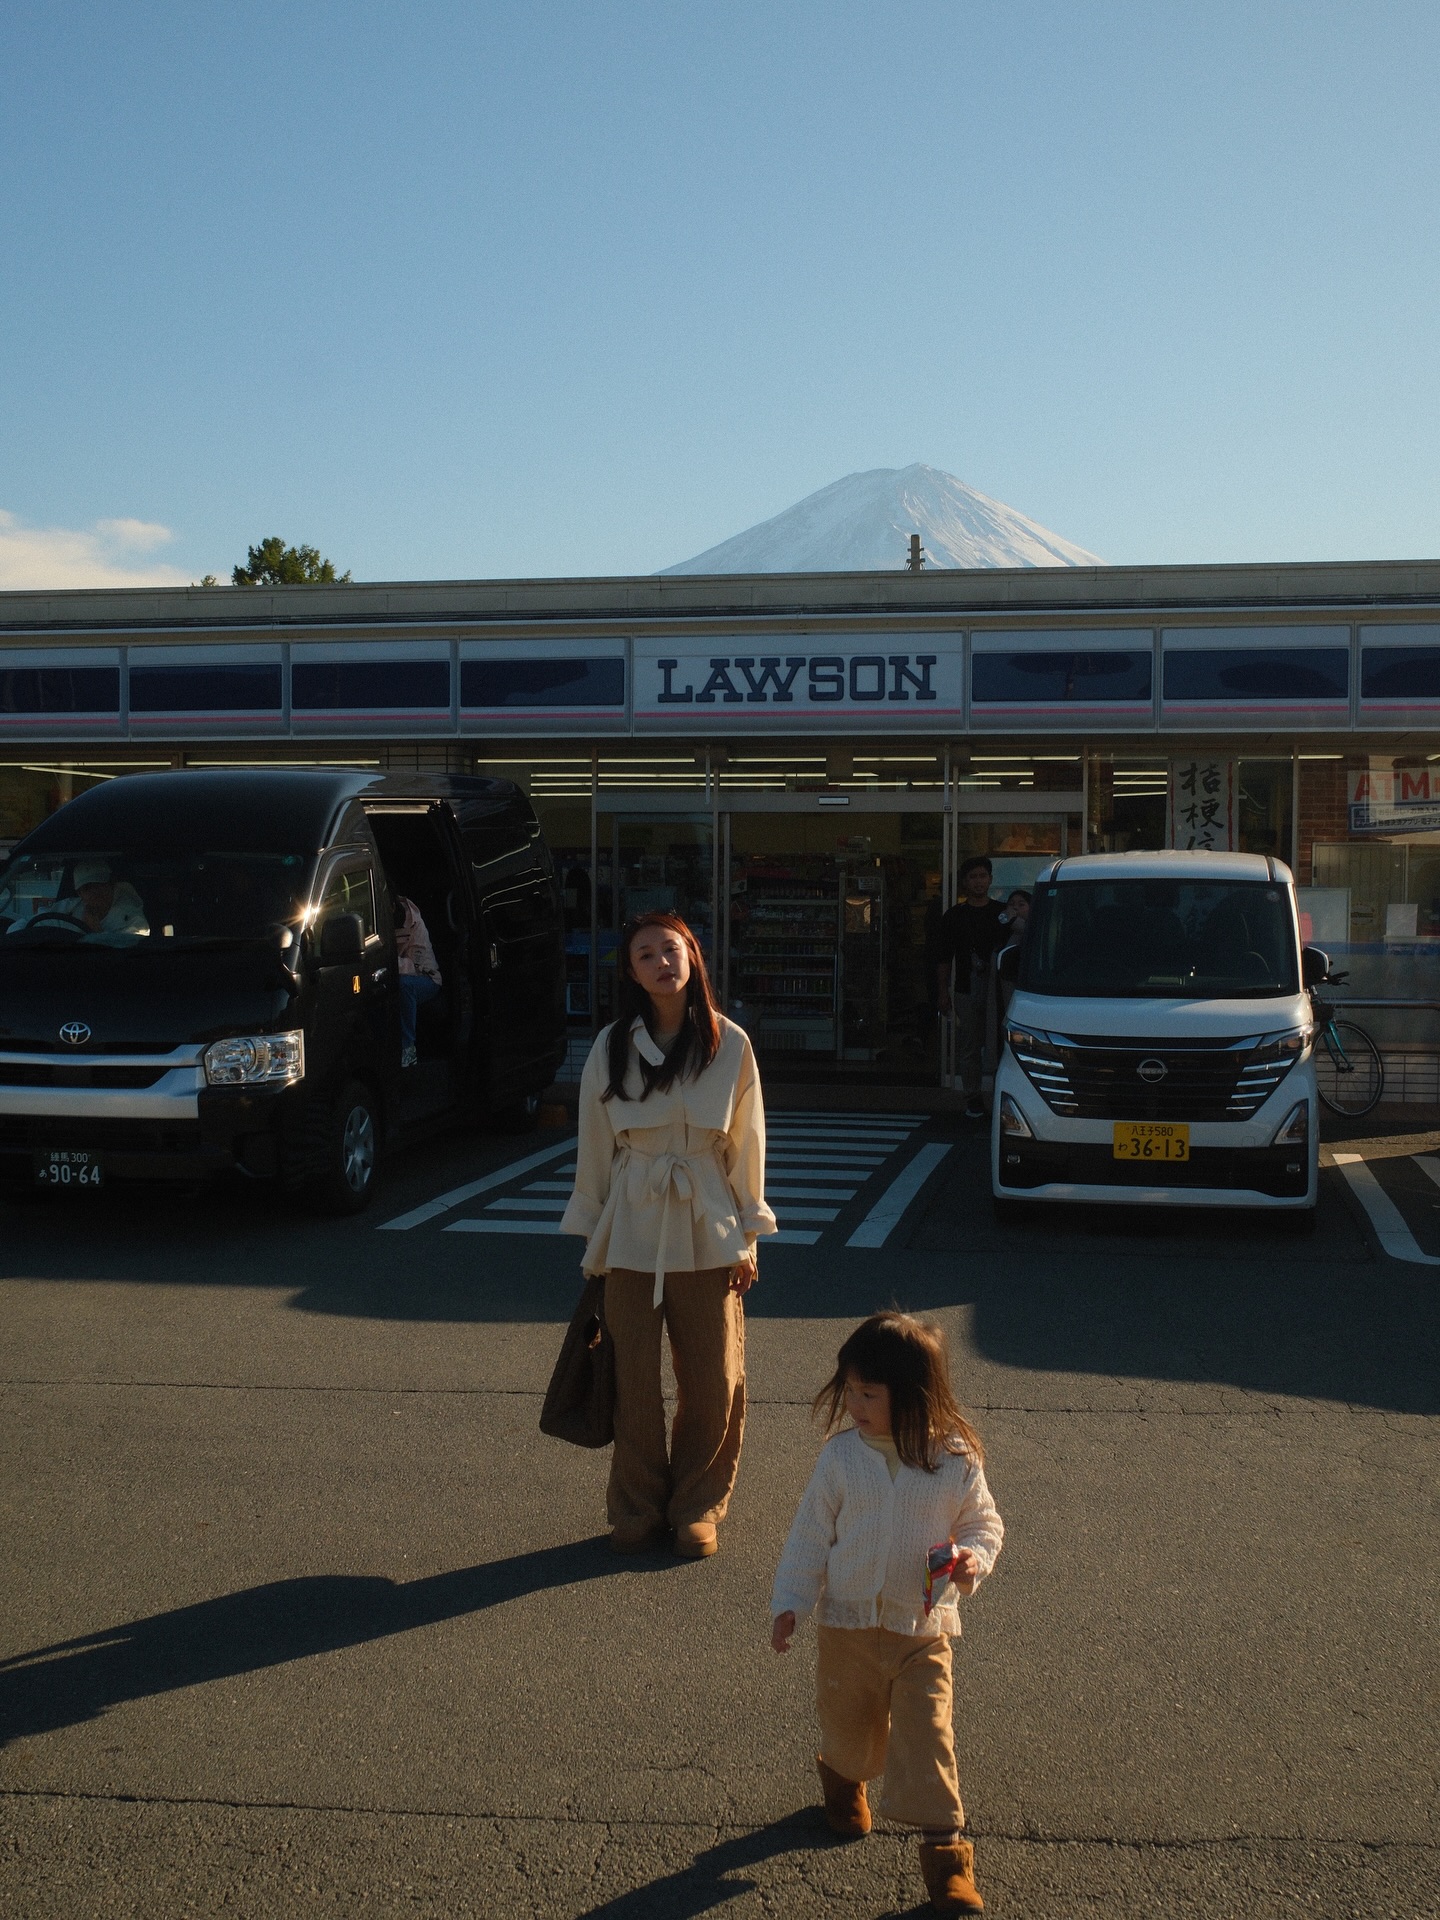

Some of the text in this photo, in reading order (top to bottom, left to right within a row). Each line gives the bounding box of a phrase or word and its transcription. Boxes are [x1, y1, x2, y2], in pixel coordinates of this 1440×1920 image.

[657, 655, 937, 703] LAWSON
[1354, 772, 1430, 801] ATM
[1154, 1127, 1174, 1136] 580
[71, 1153, 89, 1163] 300
[1118, 1138, 1185, 1158] わ 36-13
[38, 1164, 101, 1185] あ 90-64
